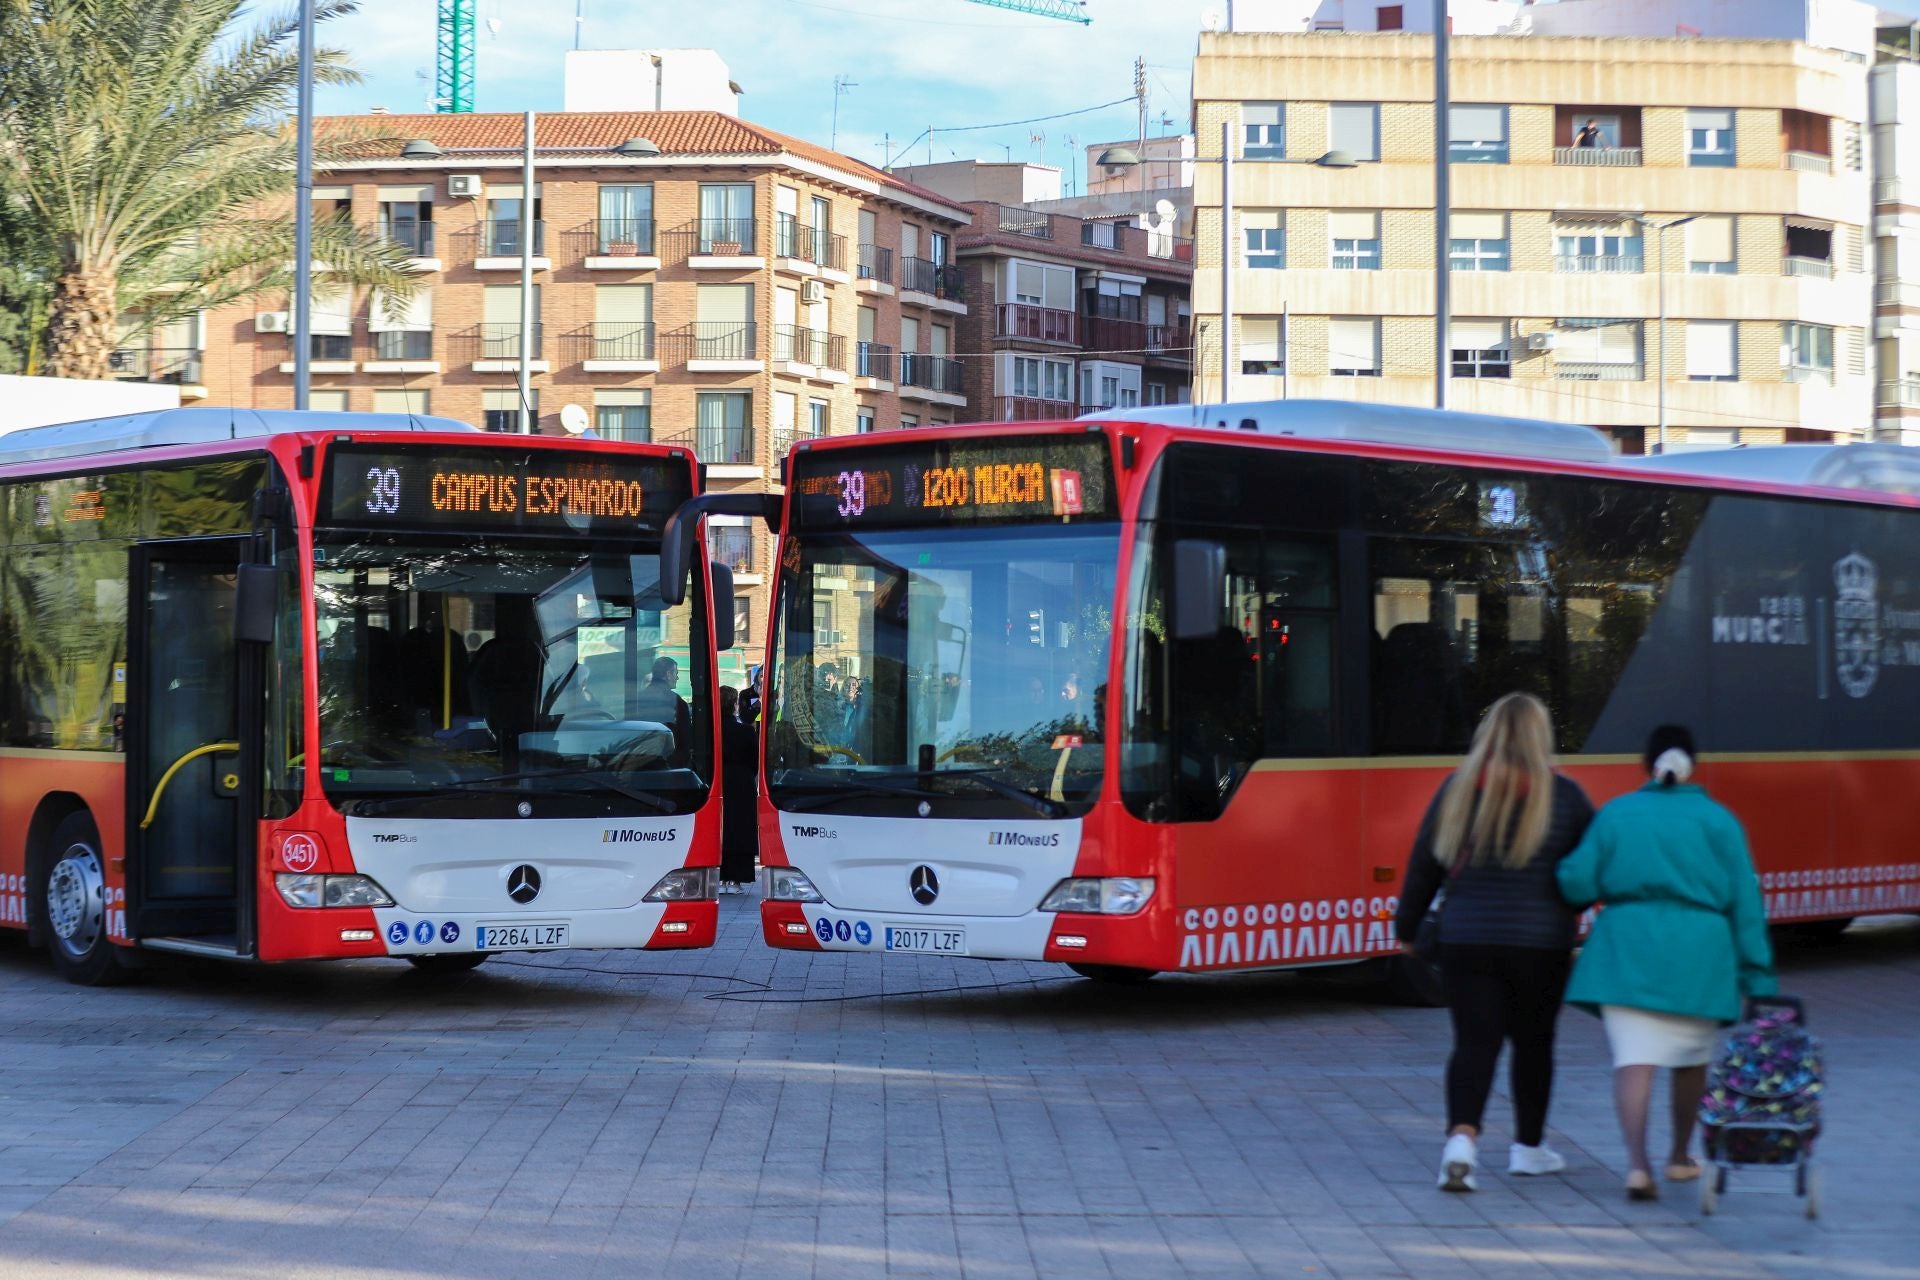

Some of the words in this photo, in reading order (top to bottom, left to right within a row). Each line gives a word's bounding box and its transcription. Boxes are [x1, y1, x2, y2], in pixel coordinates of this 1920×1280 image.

[367, 467, 399, 513] 39
[432, 473, 518, 512] CAMPUS
[526, 476, 641, 517] ESPINARDO
[838, 471, 865, 516] 39
[923, 466, 968, 506] 1200
[975, 462, 1044, 504] MURCIA
[372, 834, 417, 843] TMPBus
[792, 825, 837, 839] TMPBus
[285, 843, 312, 863] 3451
[488, 928, 528, 946] 2264
[536, 927, 565, 945] LZF
[895, 931, 928, 949] 2017
[934, 933, 960, 950] LZF
